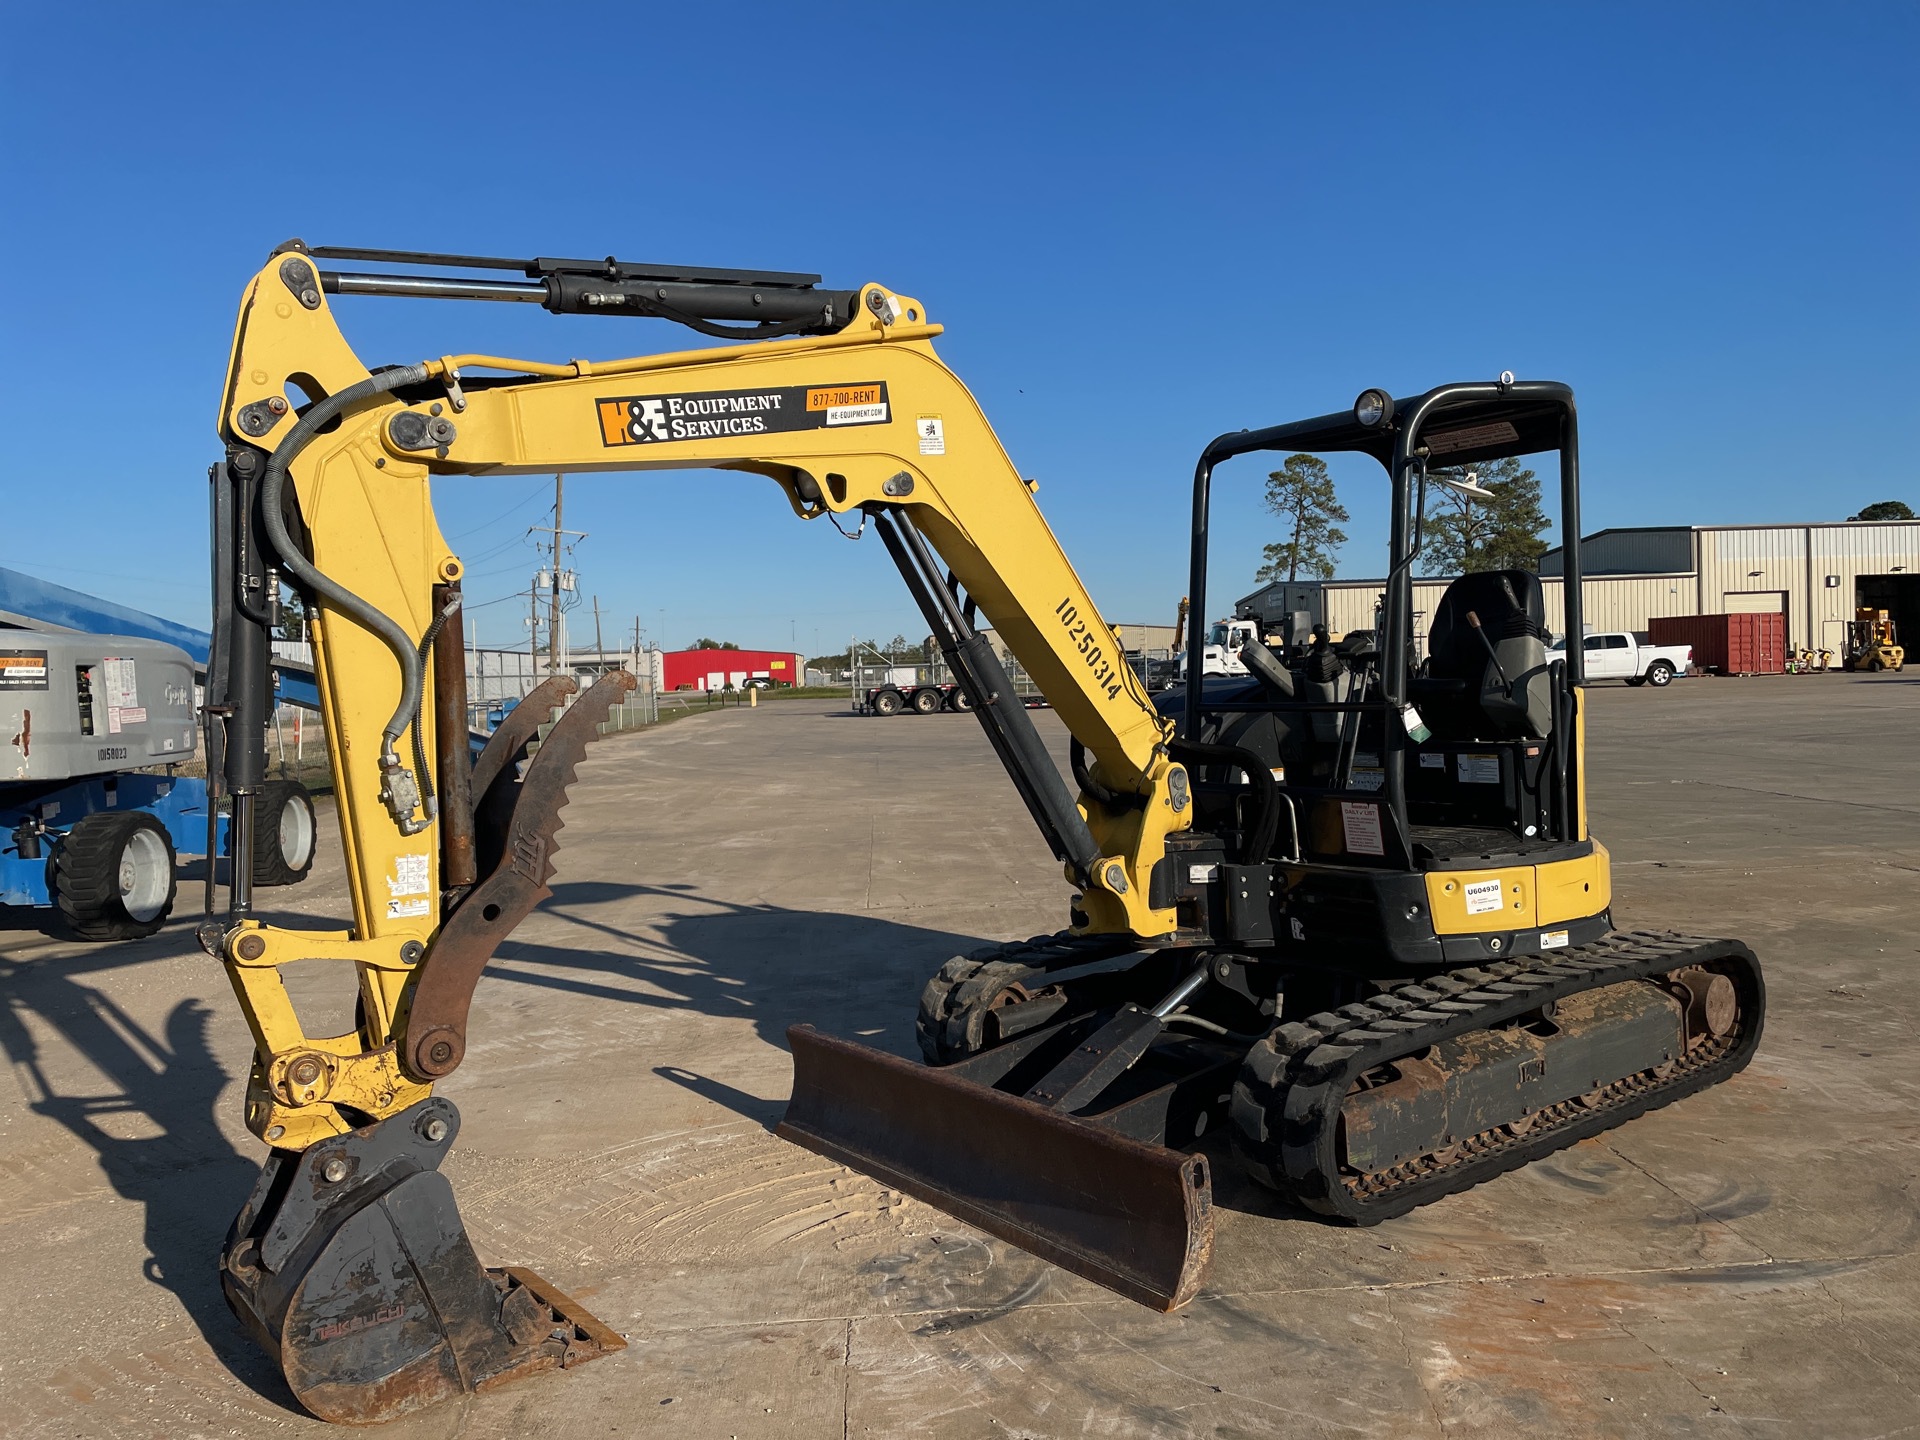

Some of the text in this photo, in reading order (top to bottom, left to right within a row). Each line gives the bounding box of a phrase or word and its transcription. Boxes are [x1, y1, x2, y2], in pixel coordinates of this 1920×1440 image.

[667, 395, 782, 416] EQUIPMENT
[813, 390, 875, 406] 877-700-RENT
[599, 399, 669, 444] H&E
[831, 408, 883, 419] HE-EQUIPMENT.COM
[1056, 597, 1122, 701] 10250314
[98, 746, 128, 761] 10158023
[1467, 884, 1499, 896] U604930
